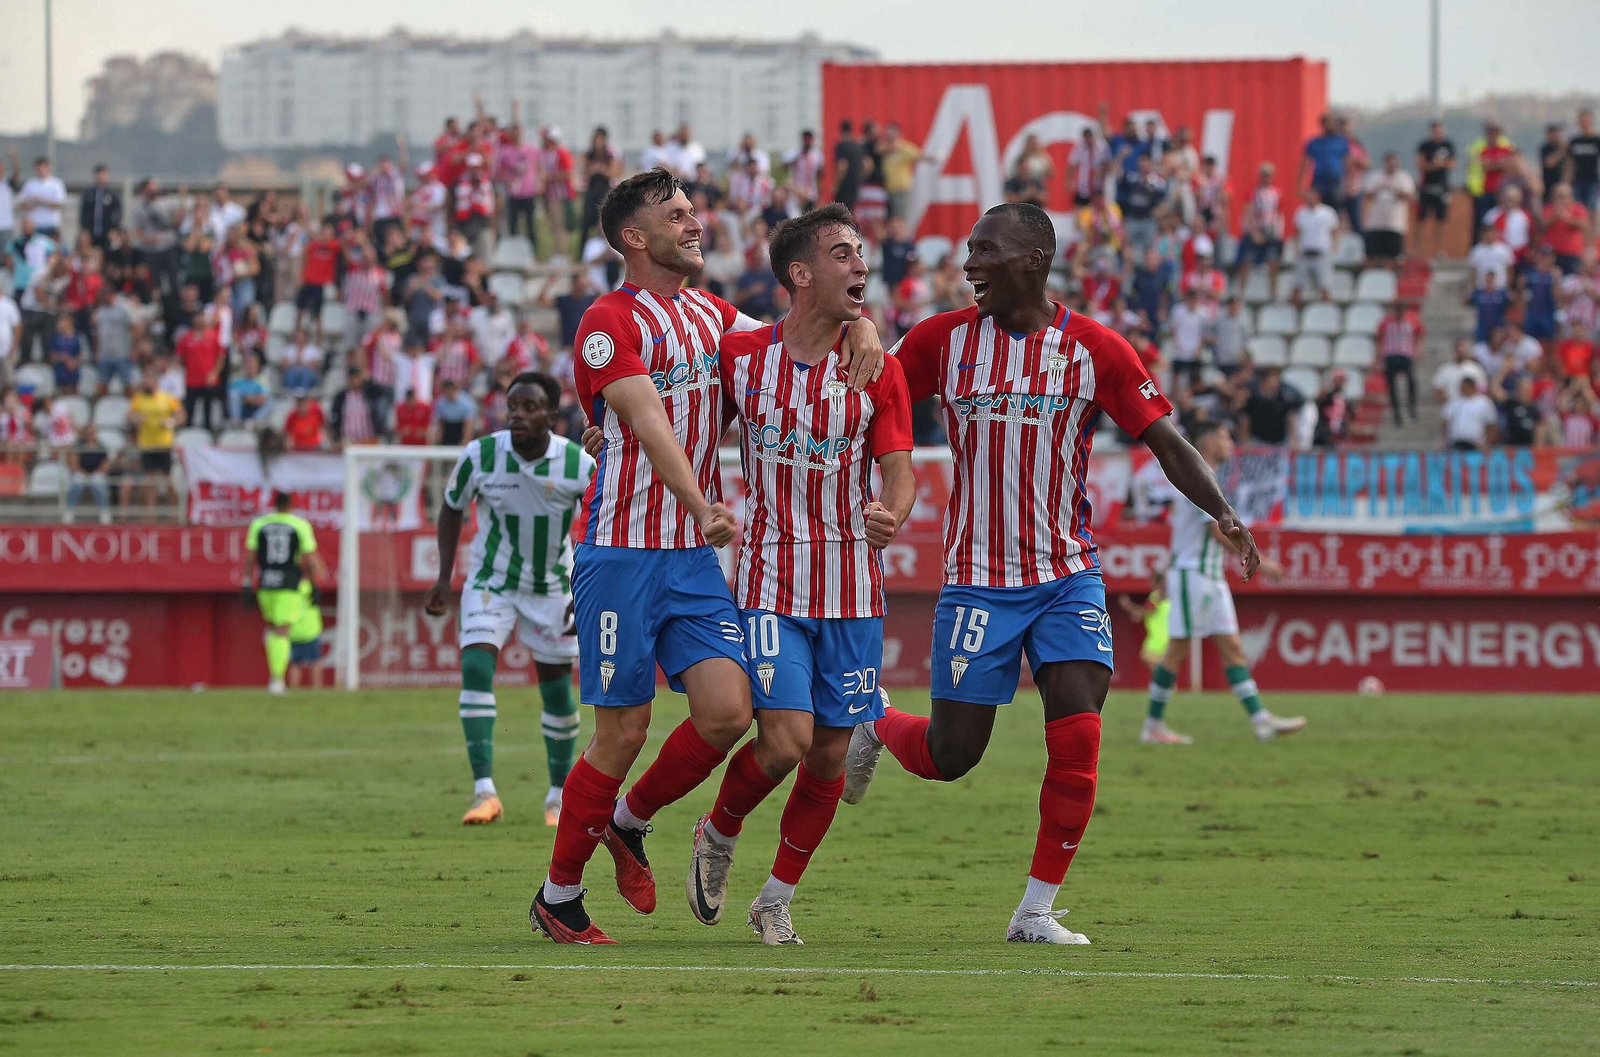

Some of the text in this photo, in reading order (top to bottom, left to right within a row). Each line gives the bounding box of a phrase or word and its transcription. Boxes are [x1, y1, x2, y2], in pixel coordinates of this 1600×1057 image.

[955, 392, 1070, 416] SCAMP
[748, 421, 850, 461] SCAMP
[600, 610, 619, 656] 8
[747, 613, 781, 660] 10
[949, 606, 990, 653] 15
